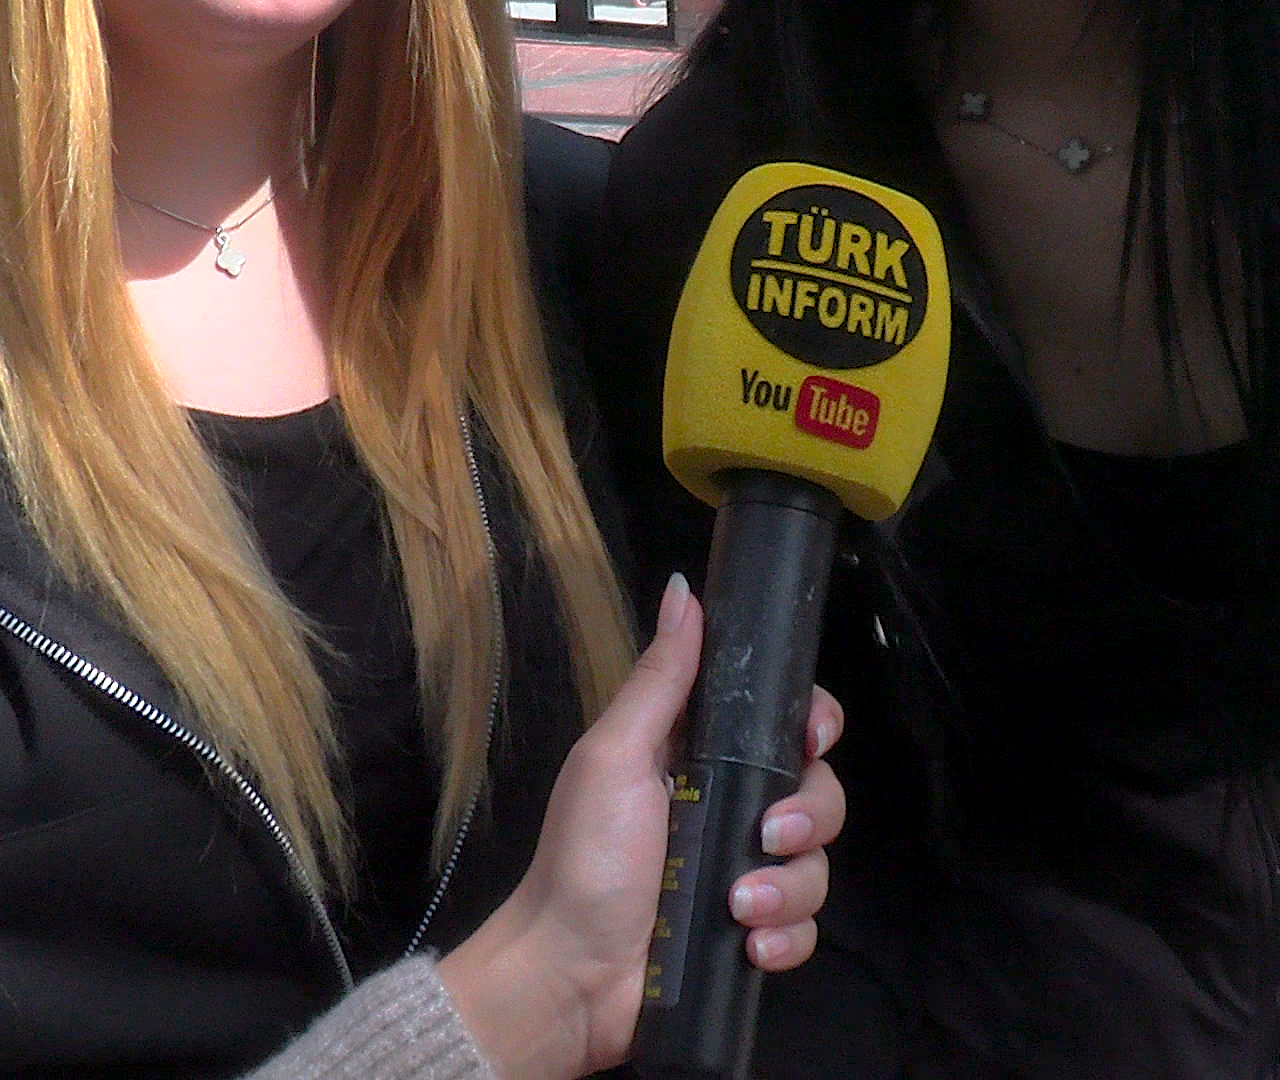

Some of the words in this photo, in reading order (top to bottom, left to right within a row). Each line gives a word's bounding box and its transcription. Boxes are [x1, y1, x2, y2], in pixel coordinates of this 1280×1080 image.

[762, 205, 910, 289] TÜRK
[746, 272, 910, 346] INFORM
[740, 367, 793, 412] You
[809, 383, 871, 437] Tube
